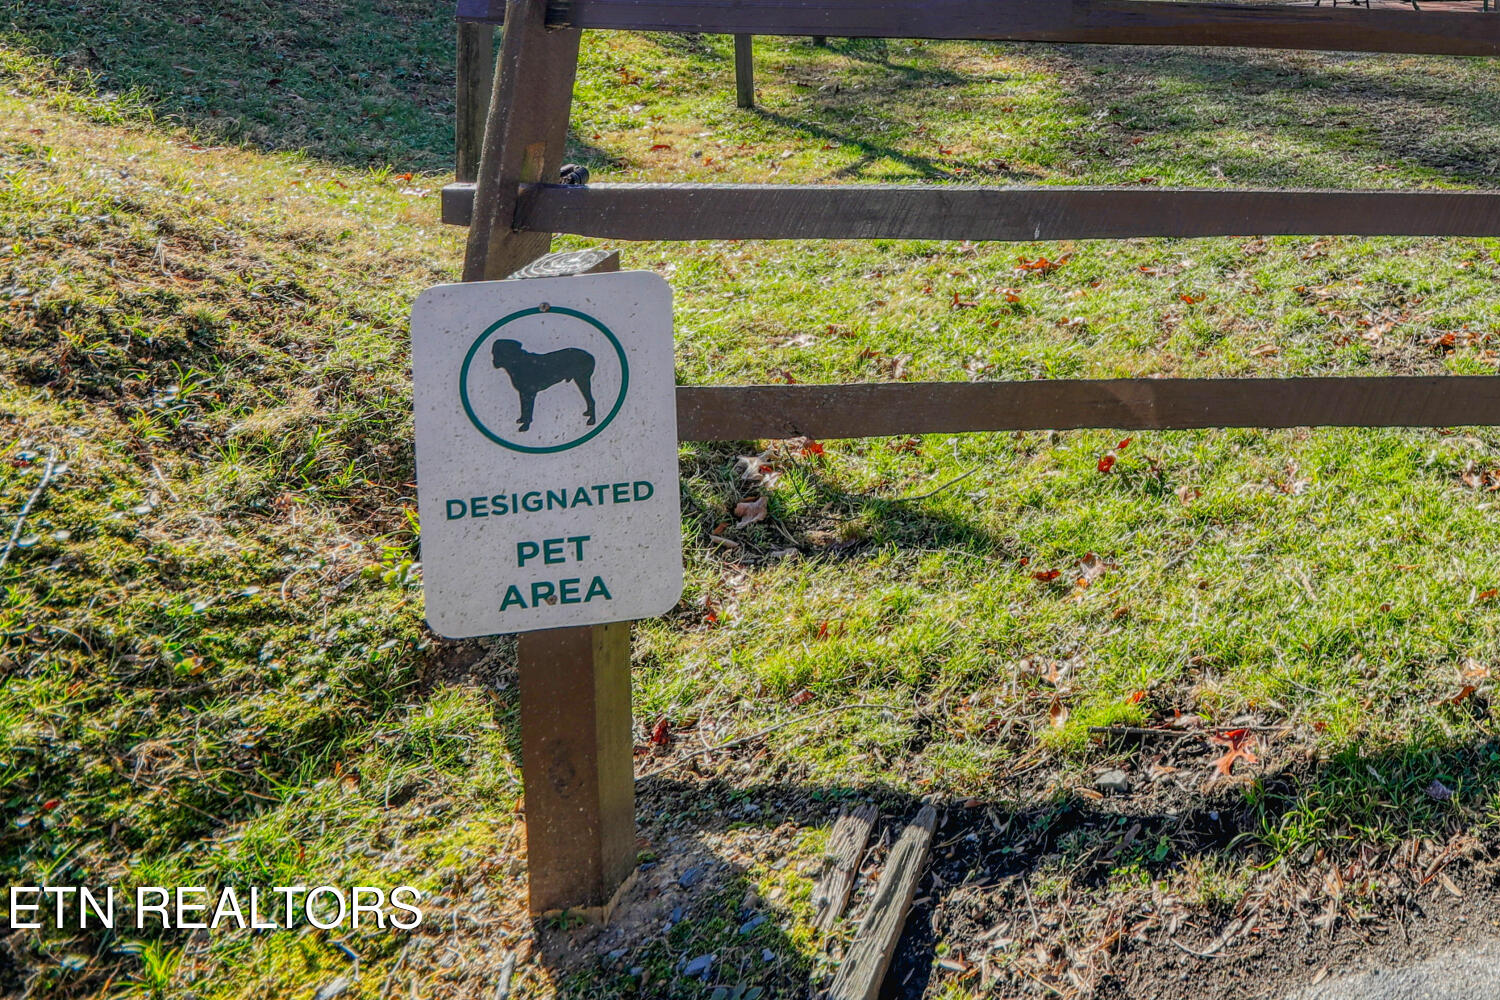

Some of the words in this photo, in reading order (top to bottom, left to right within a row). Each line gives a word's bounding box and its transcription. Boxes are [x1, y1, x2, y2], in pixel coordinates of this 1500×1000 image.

[445, 480, 655, 521] DESIGNATED
[516, 535, 591, 568] PET
[499, 575, 612, 612] AREA
